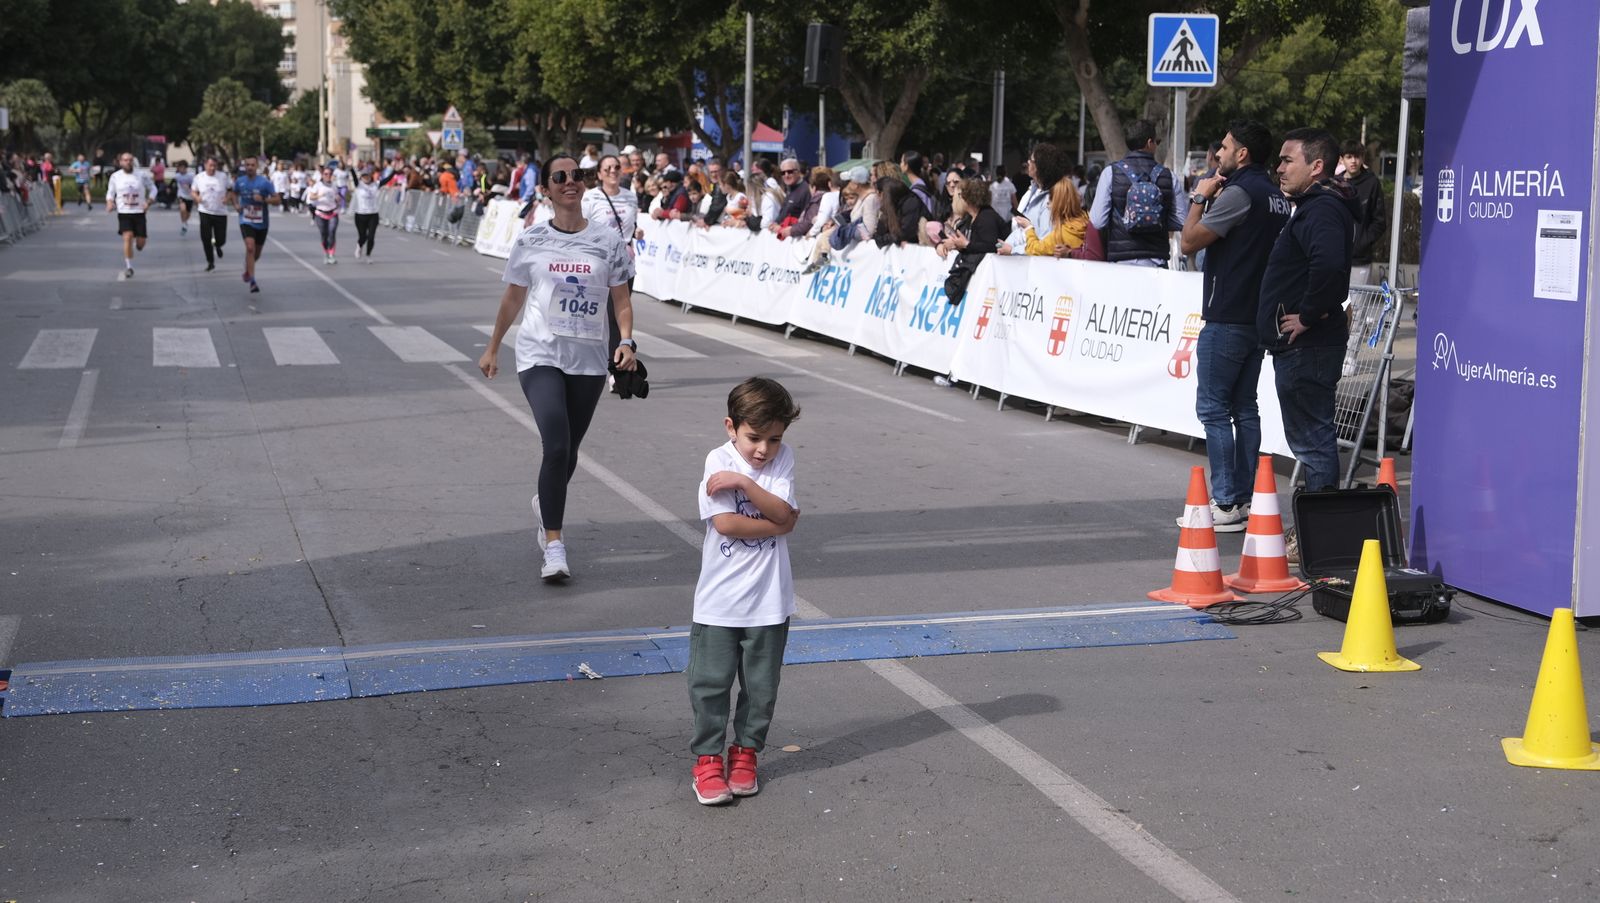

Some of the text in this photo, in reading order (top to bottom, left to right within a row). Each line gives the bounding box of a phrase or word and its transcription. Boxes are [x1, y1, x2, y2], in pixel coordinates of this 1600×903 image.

[1469, 163, 1565, 197] ALMERÍA
[1468, 202, 1513, 220] CIUDAD
[549, 263, 591, 274] MUJER
[806, 264, 853, 308] NEXA
[864, 274, 904, 322] NEXA
[559, 298, 599, 316] 1045
[909, 285, 969, 339] NEXA
[1085, 303, 1172, 344] ALMERÍA
[1080, 337, 1123, 363] CIUDAD
